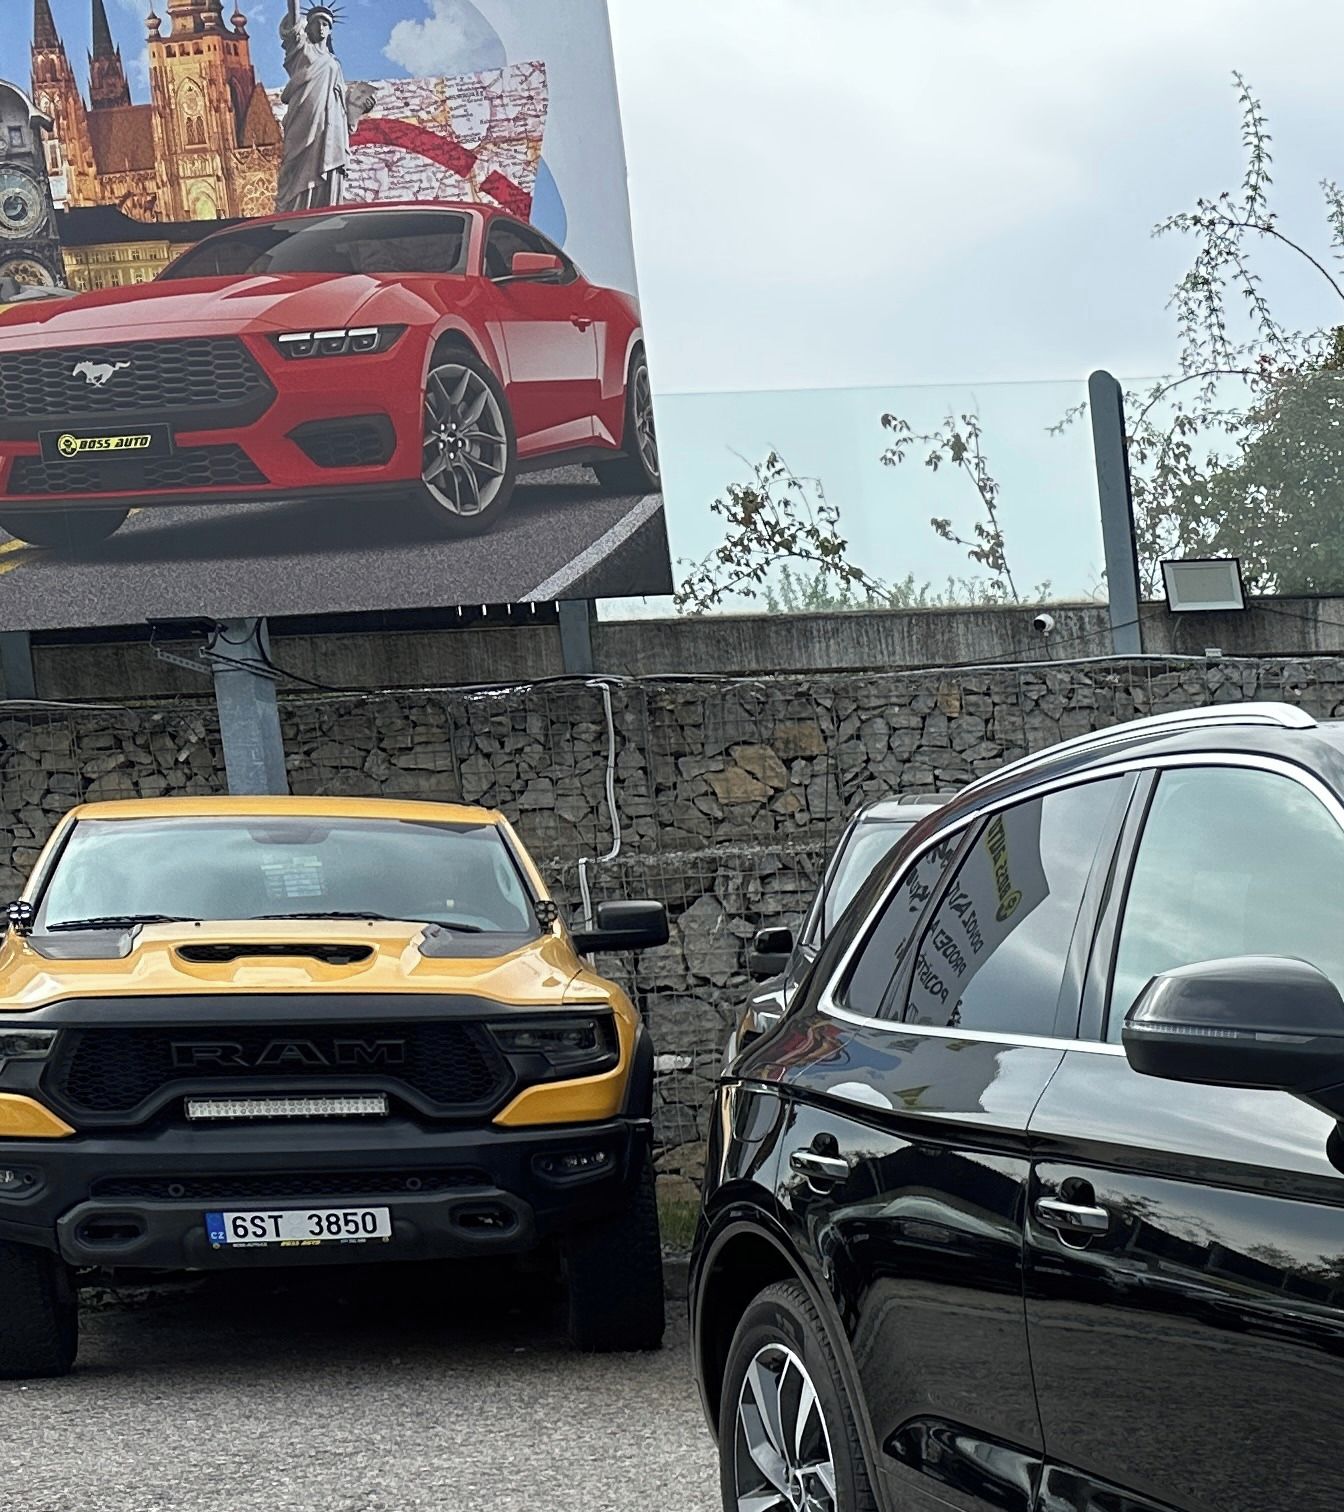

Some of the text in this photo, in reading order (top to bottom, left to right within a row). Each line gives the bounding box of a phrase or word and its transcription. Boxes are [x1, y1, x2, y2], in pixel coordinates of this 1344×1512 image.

[80, 436, 149, 450] BOSS AUTO
[170, 1039, 406, 1067] RAM
[211, 1211, 378, 1240] CZ 6ST 3850
